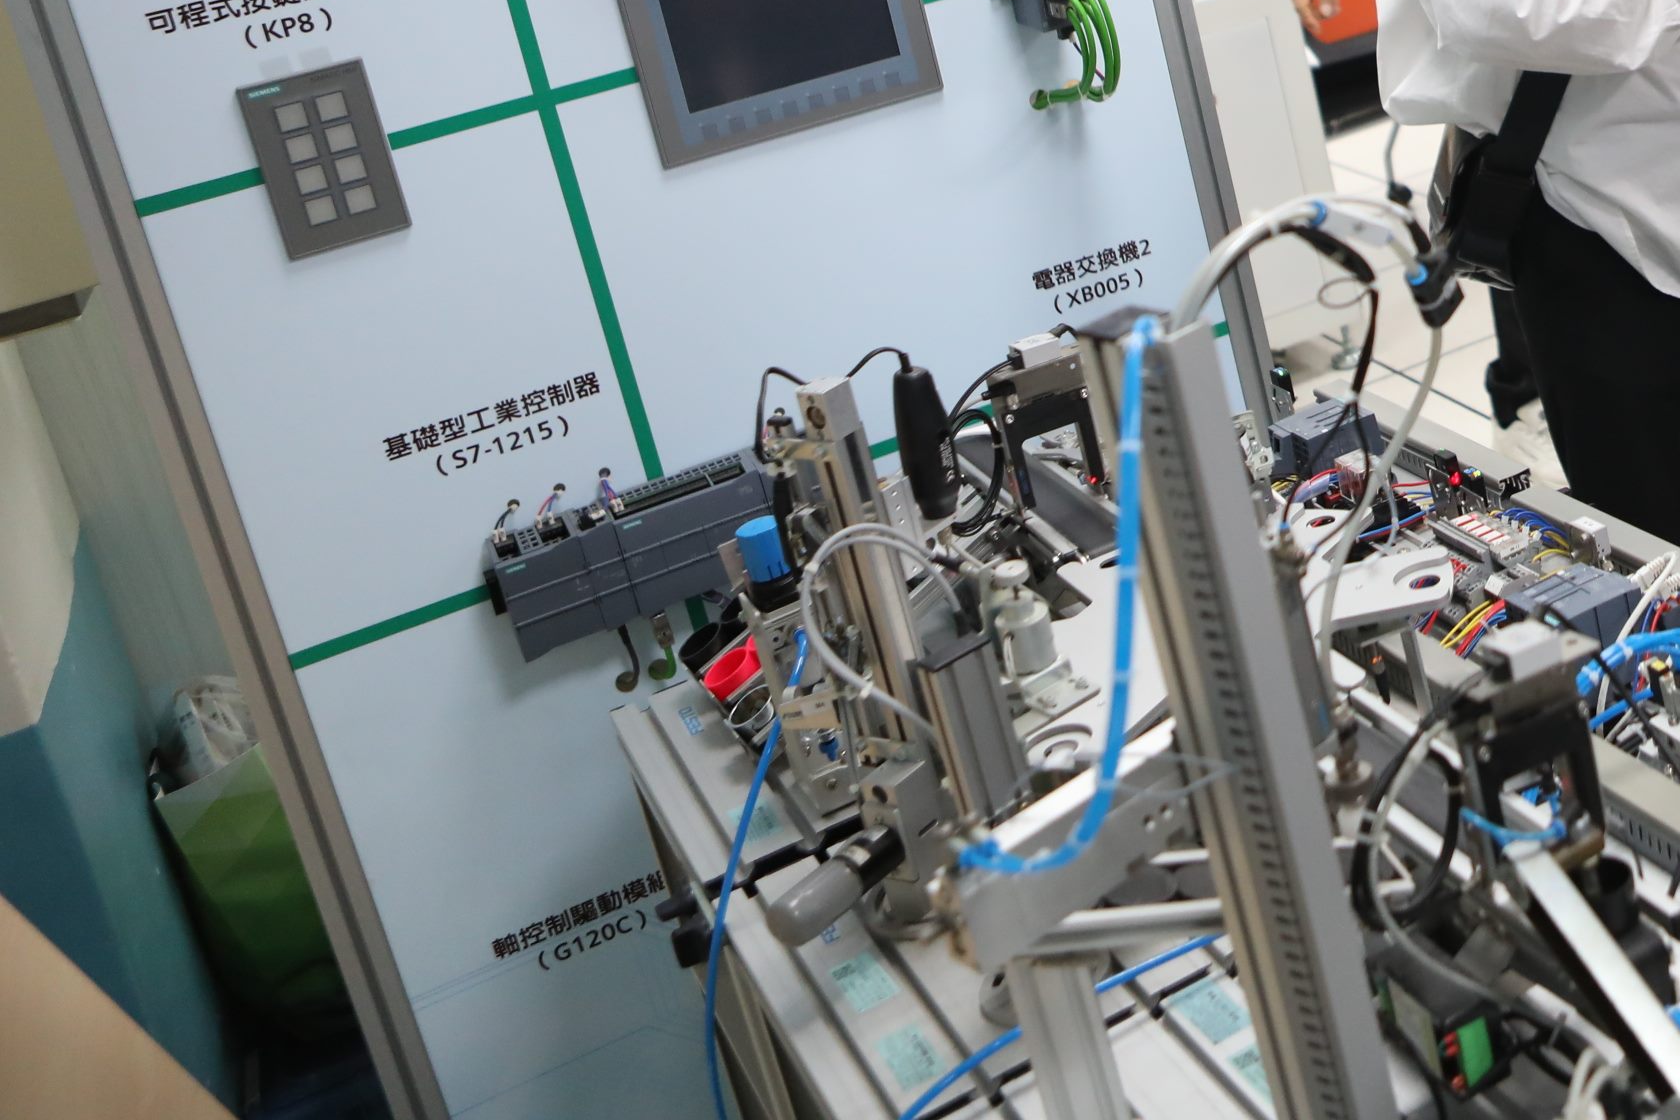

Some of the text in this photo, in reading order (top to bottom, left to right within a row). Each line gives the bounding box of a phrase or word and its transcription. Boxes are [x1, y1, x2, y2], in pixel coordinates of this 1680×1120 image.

[244, 7, 334, 50] (KP8)
[1031, 238, 1152, 293] 電器交換機2
[1053, 267, 1145, 316] (XB005)
[383, 371, 601, 463] 基礎型工業控制器
[435, 414, 570, 477] (S7-1215)
[538, 910, 646, 970] (G120C)
